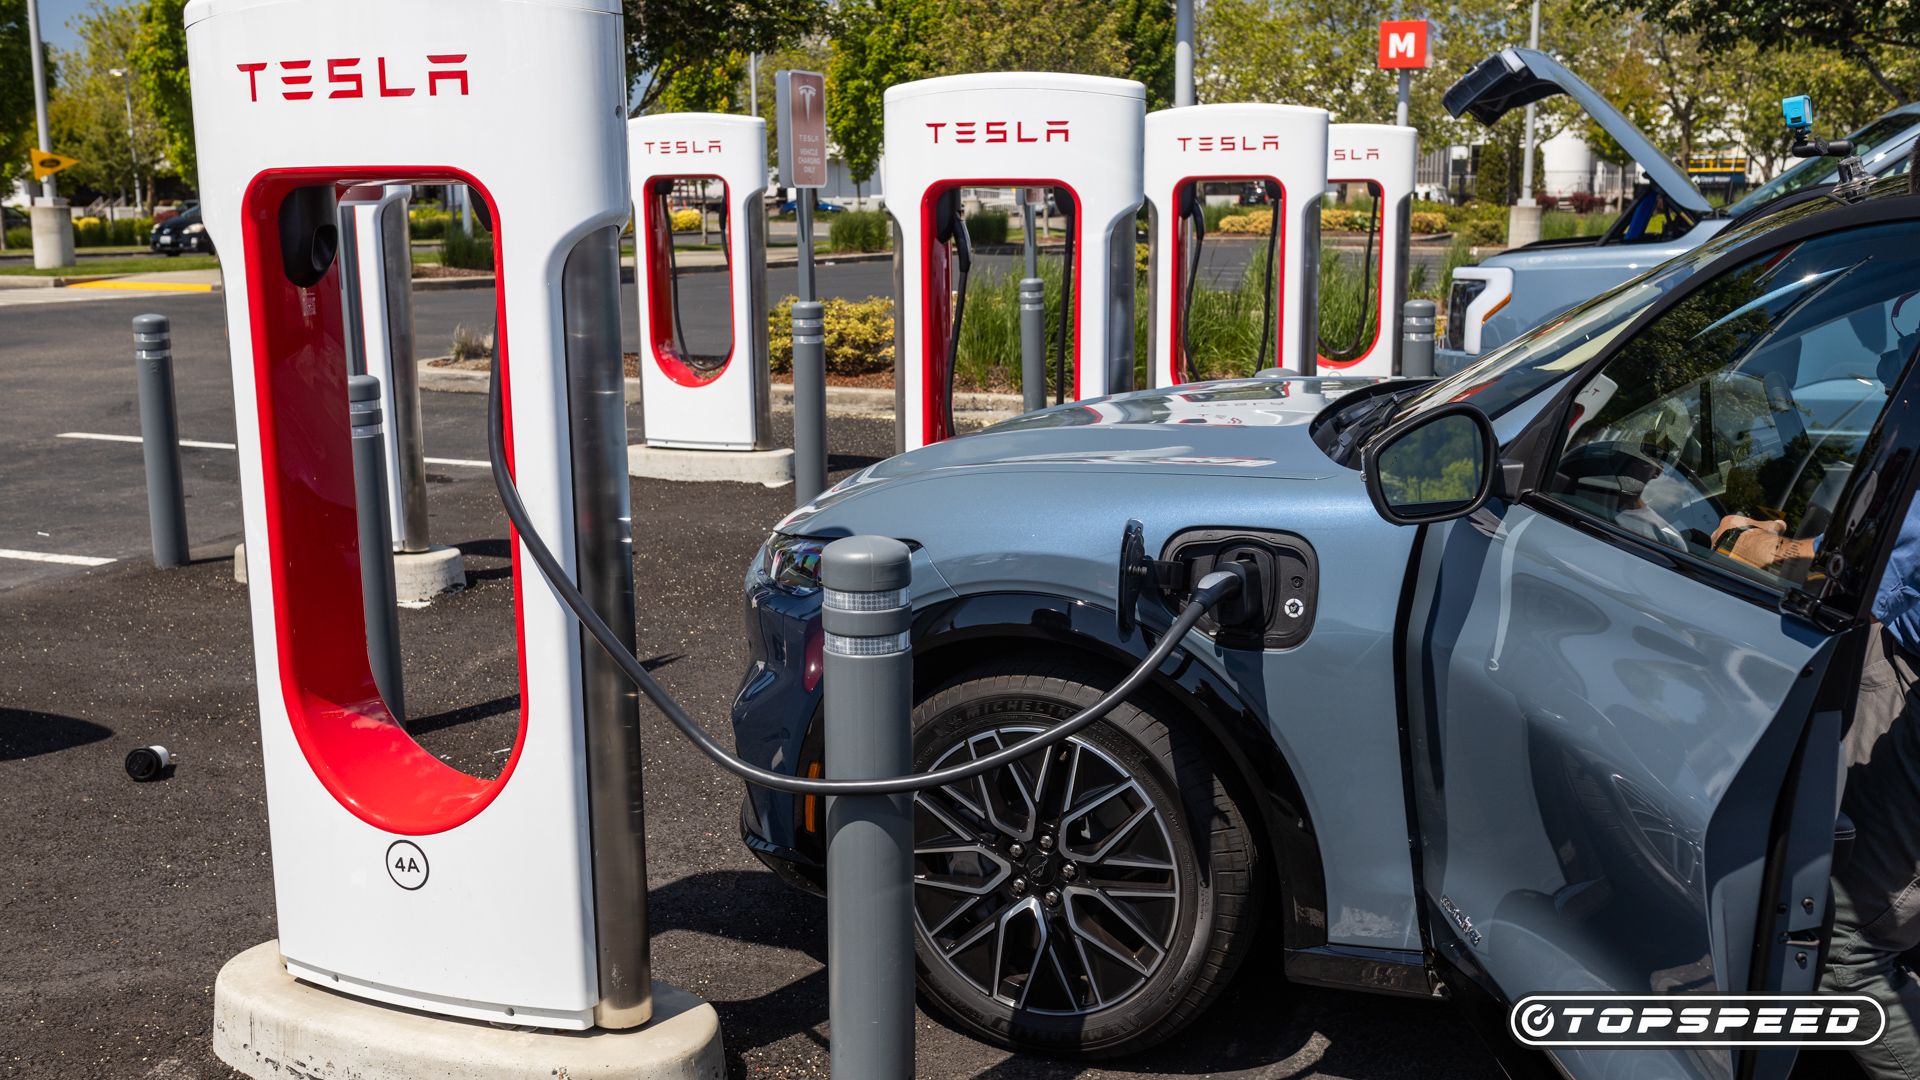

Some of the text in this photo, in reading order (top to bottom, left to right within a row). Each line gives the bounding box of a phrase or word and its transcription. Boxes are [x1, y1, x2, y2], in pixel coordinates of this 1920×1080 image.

[1388, 32, 1415, 59] M
[236, 53, 470, 103] TESLA
[799, 134, 819, 142] TESLA
[926, 120, 1070, 145] TESLA
[644, 140, 722, 155] TESLA
[800, 148, 818, 156] VEHICLE
[1176, 135, 1280, 152] TESLA
[798, 157, 821, 165] CHARGING
[1333, 148, 1380, 161] SLA
[965, 700, 1072, 719] MICHELIN
[394, 856, 421, 873] 4A
